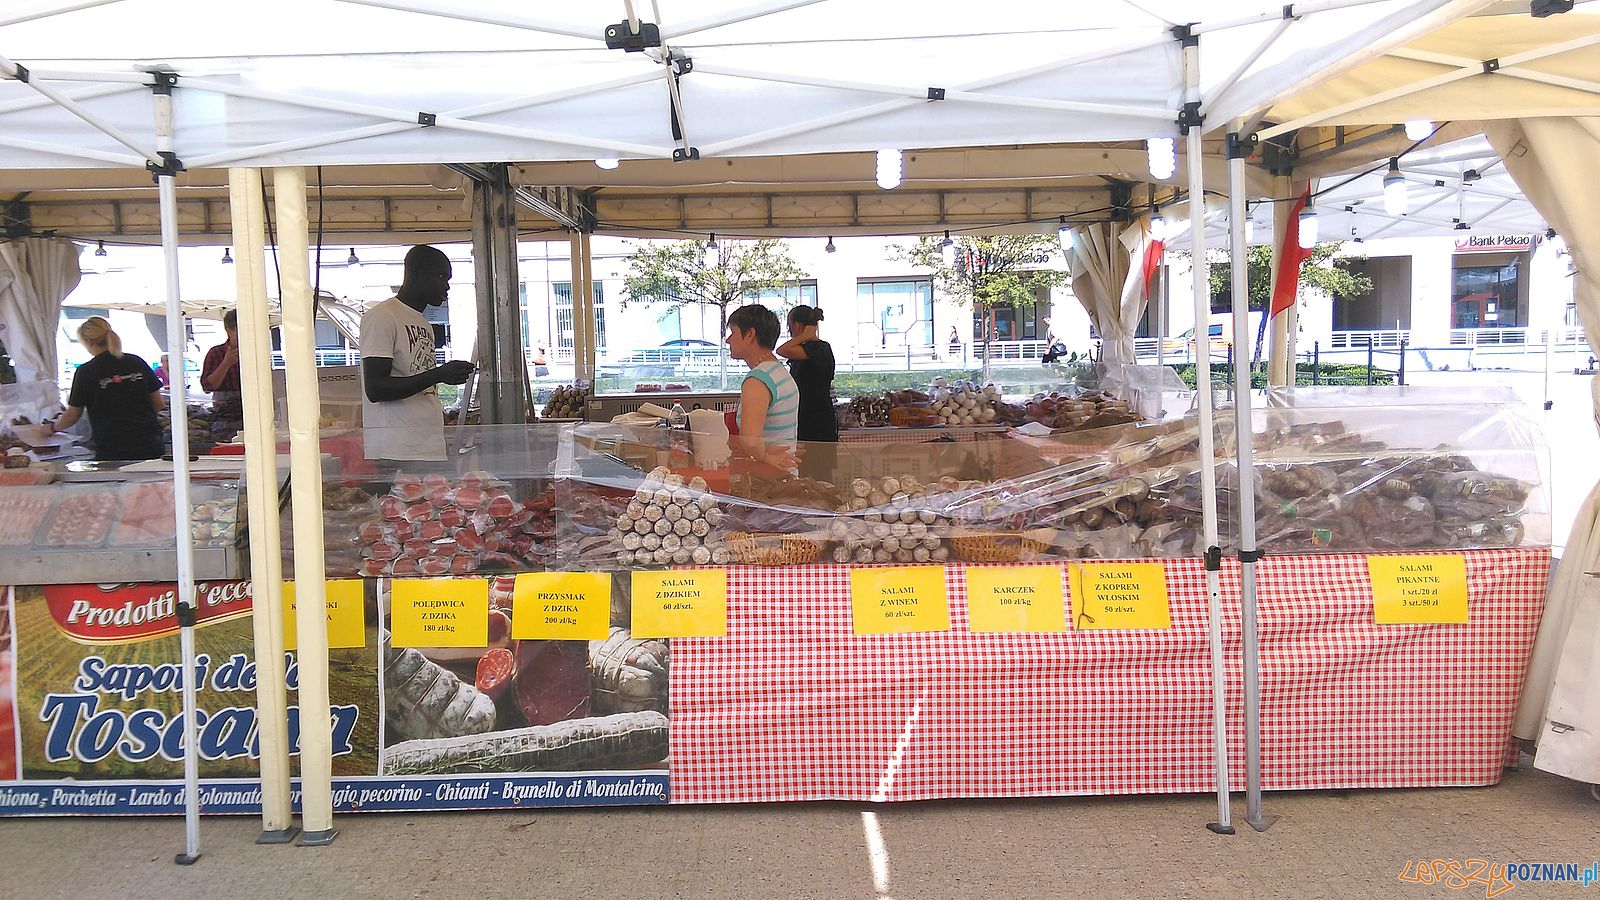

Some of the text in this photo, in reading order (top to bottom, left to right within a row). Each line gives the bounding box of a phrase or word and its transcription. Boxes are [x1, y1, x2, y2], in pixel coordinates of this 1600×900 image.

[1469, 234, 1530, 247] Bank Pekao
[1399, 564, 1433, 572] SALAMI
[661, 579, 695, 587] SALAMI
[1094, 583, 1140, 591] Z KOPREM
[881, 586, 915, 595] SALAMI
[993, 586, 1036, 594] KARCZEK
[537, 592, 586, 601] PRZYSMAK
[655, 590, 701, 599] Z DZIKIEM
[413, 600, 465, 609] POLĘDWICA
[880, 598, 918, 607] Z WINEM
[1402, 599, 1407, 607] 3
[66, 590, 176, 627] Prodotti
[543, 604, 579, 612] Z DZIKA
[1104, 605, 1113, 613] 50
[421, 612, 457, 620] Z DZIKA
[544, 616, 558, 624] 200
[423, 624, 436, 632] 180
[74, 653, 212, 701] Sapori
[51, 787, 117, 806] Porchetta
[128, 787, 171, 806] Lardo
[358, 783, 422, 806] pecorino
[435, 781, 491, 801] Chianti
[502, 780, 563, 800] Brunello
[565, 779, 582, 798] di
[584, 778, 663, 798] Montalcino
